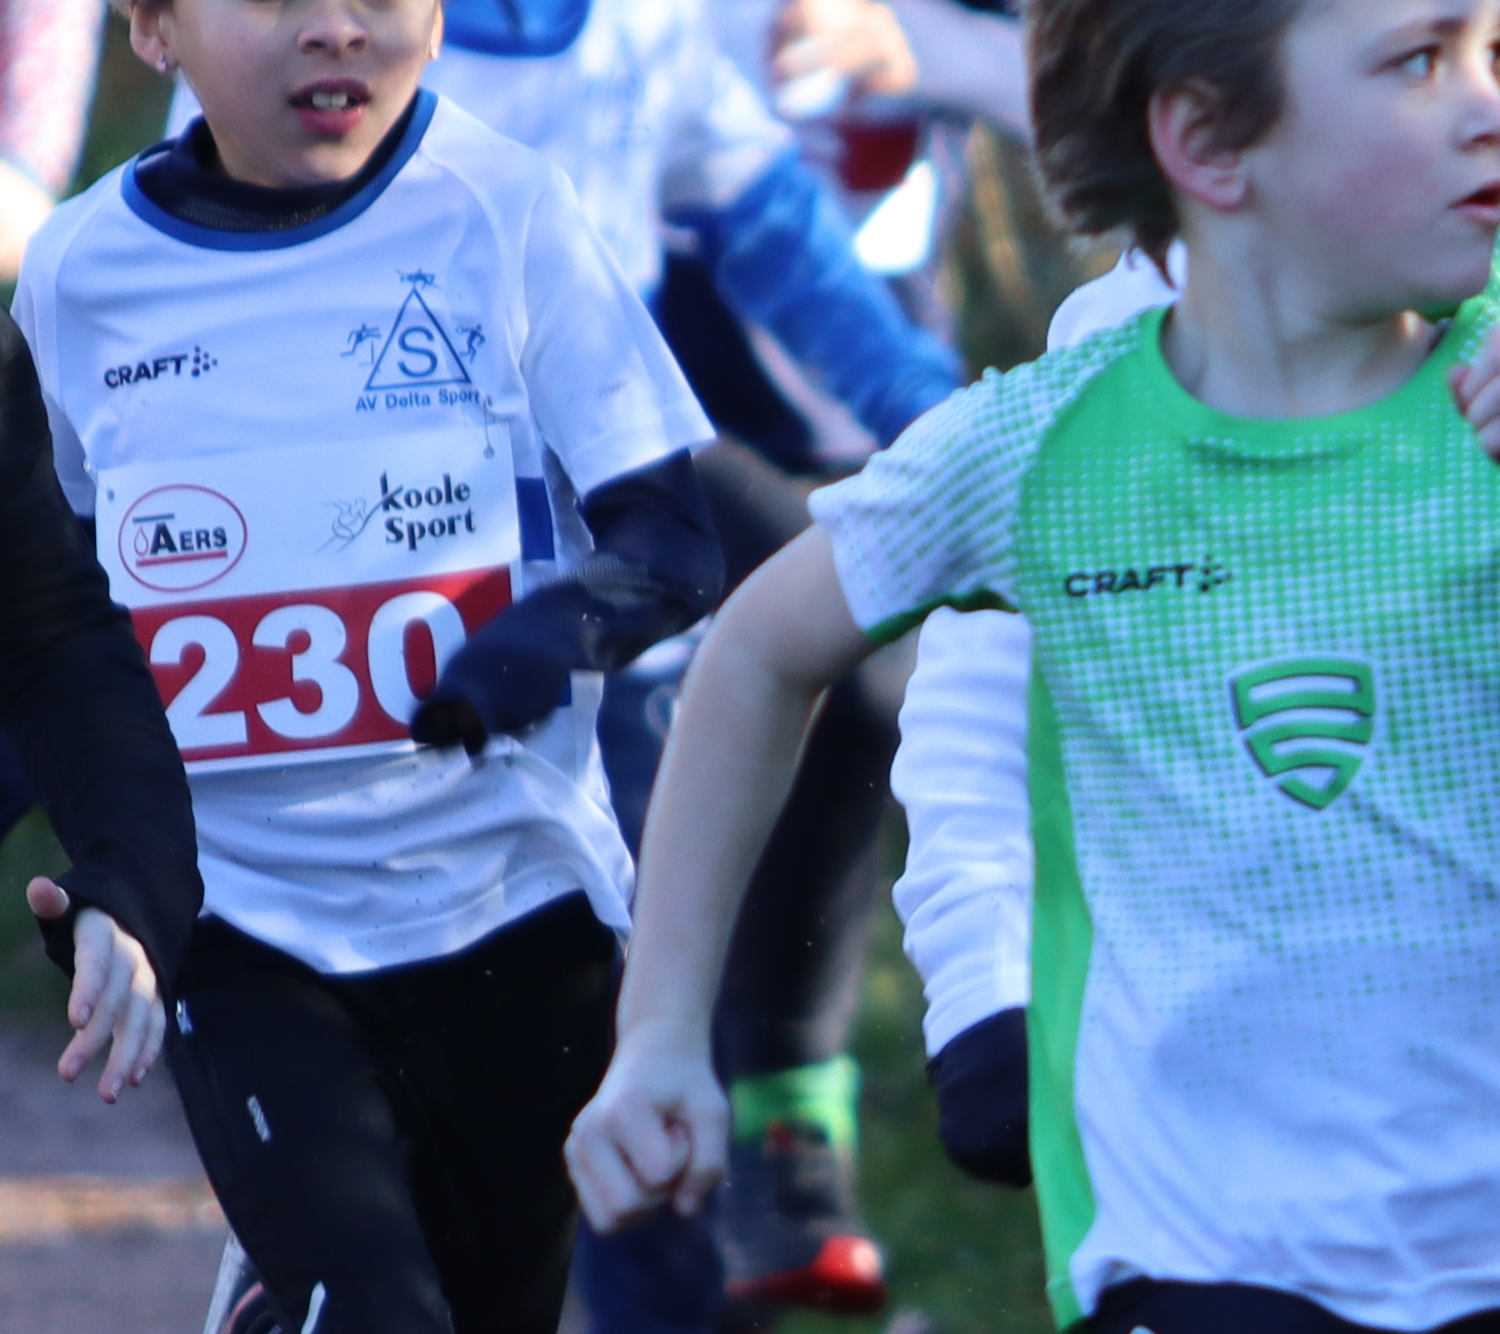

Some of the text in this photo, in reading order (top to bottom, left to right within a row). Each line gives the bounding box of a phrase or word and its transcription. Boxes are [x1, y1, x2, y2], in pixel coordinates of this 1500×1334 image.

[398, 326, 438, 378] S
[104, 353, 189, 389] CRAFT
[355, 388, 480, 412] AV Delta Sport
[149, 521, 228, 555] AERS
[384, 505, 477, 551] Sport
[1065, 563, 1195, 598] CRAFT
[148, 590, 467, 750] 230
